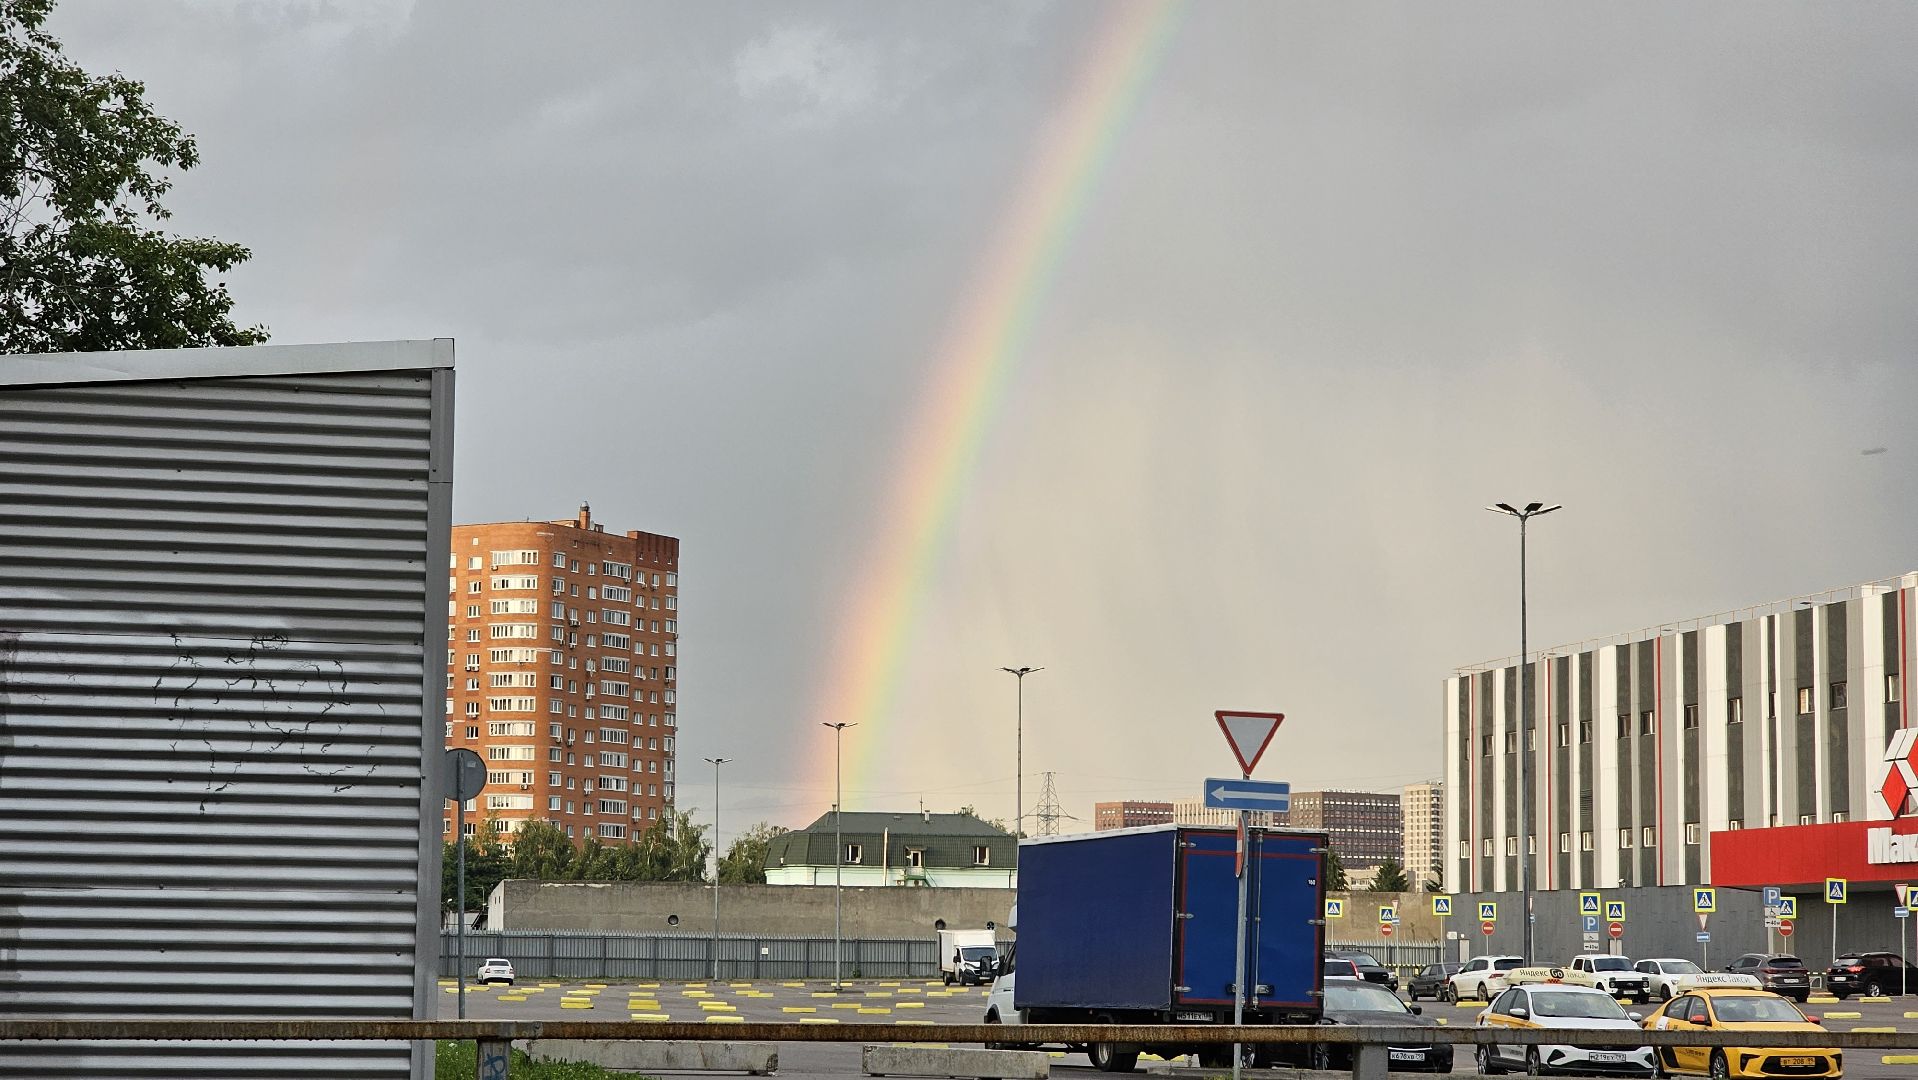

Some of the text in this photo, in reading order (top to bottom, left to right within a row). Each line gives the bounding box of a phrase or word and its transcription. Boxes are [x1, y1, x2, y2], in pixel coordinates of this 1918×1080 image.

[1519, 968, 1549, 977] Яндекс
[1551, 969, 1563, 978] Go
[1695, 974, 1727, 983] Яндекс
